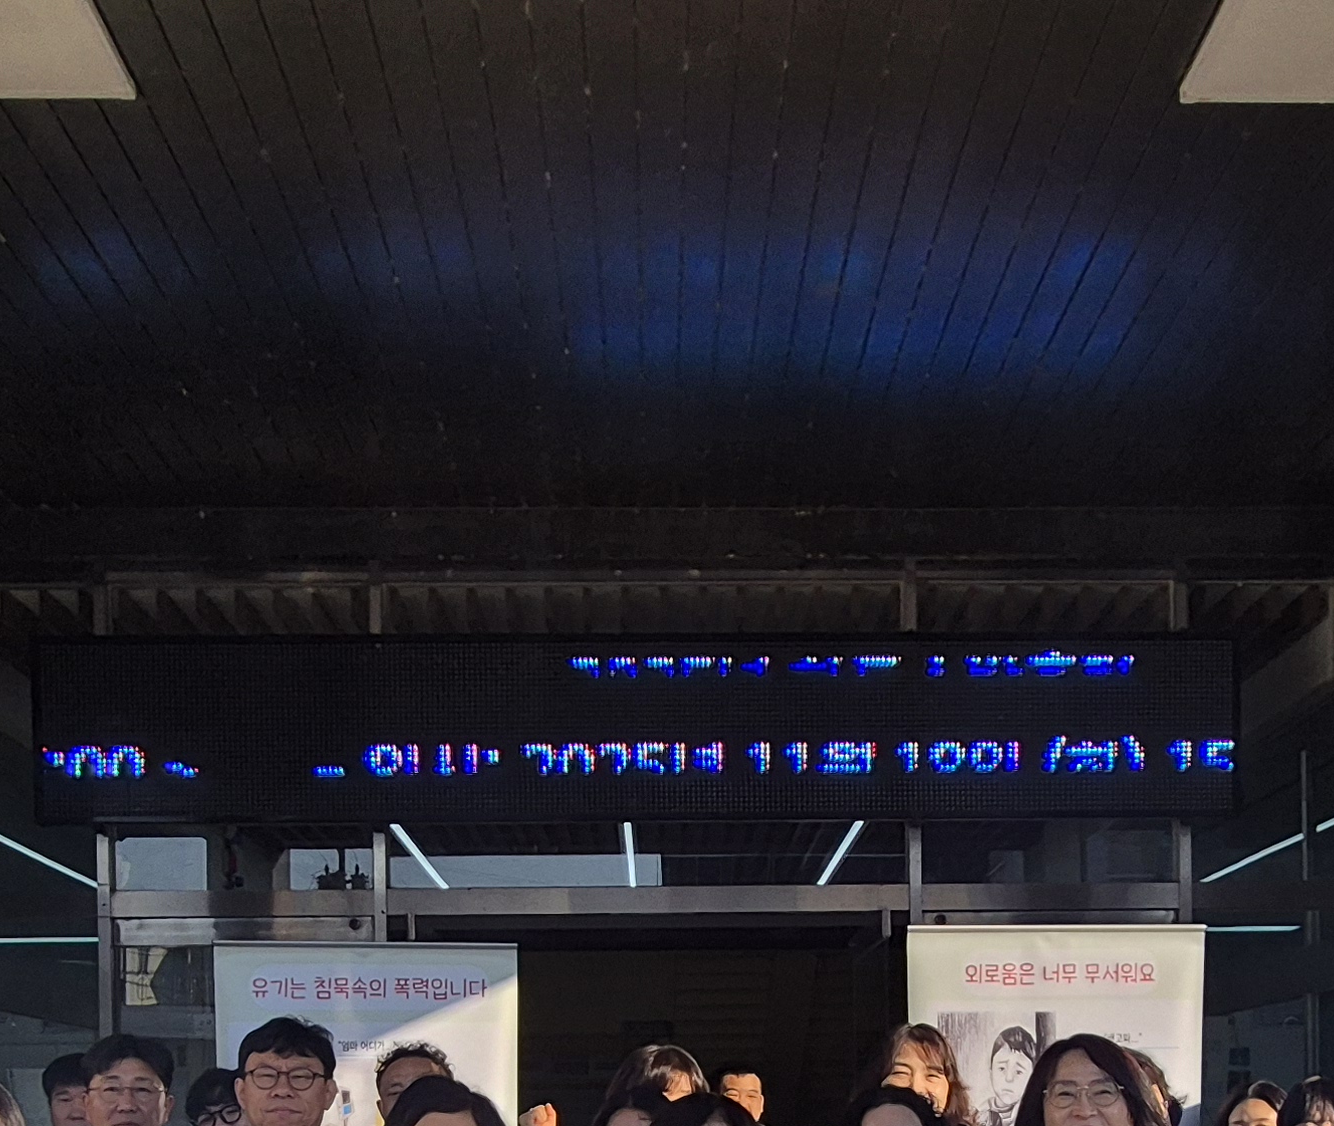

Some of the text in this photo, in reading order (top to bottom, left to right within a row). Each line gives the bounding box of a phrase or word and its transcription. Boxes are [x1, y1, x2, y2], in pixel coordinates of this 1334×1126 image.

[965, 962, 1156, 986] 외로움은 너무 무서워요
[252, 976, 488, 1000] 유기는 침묵속의 폭력입니다
